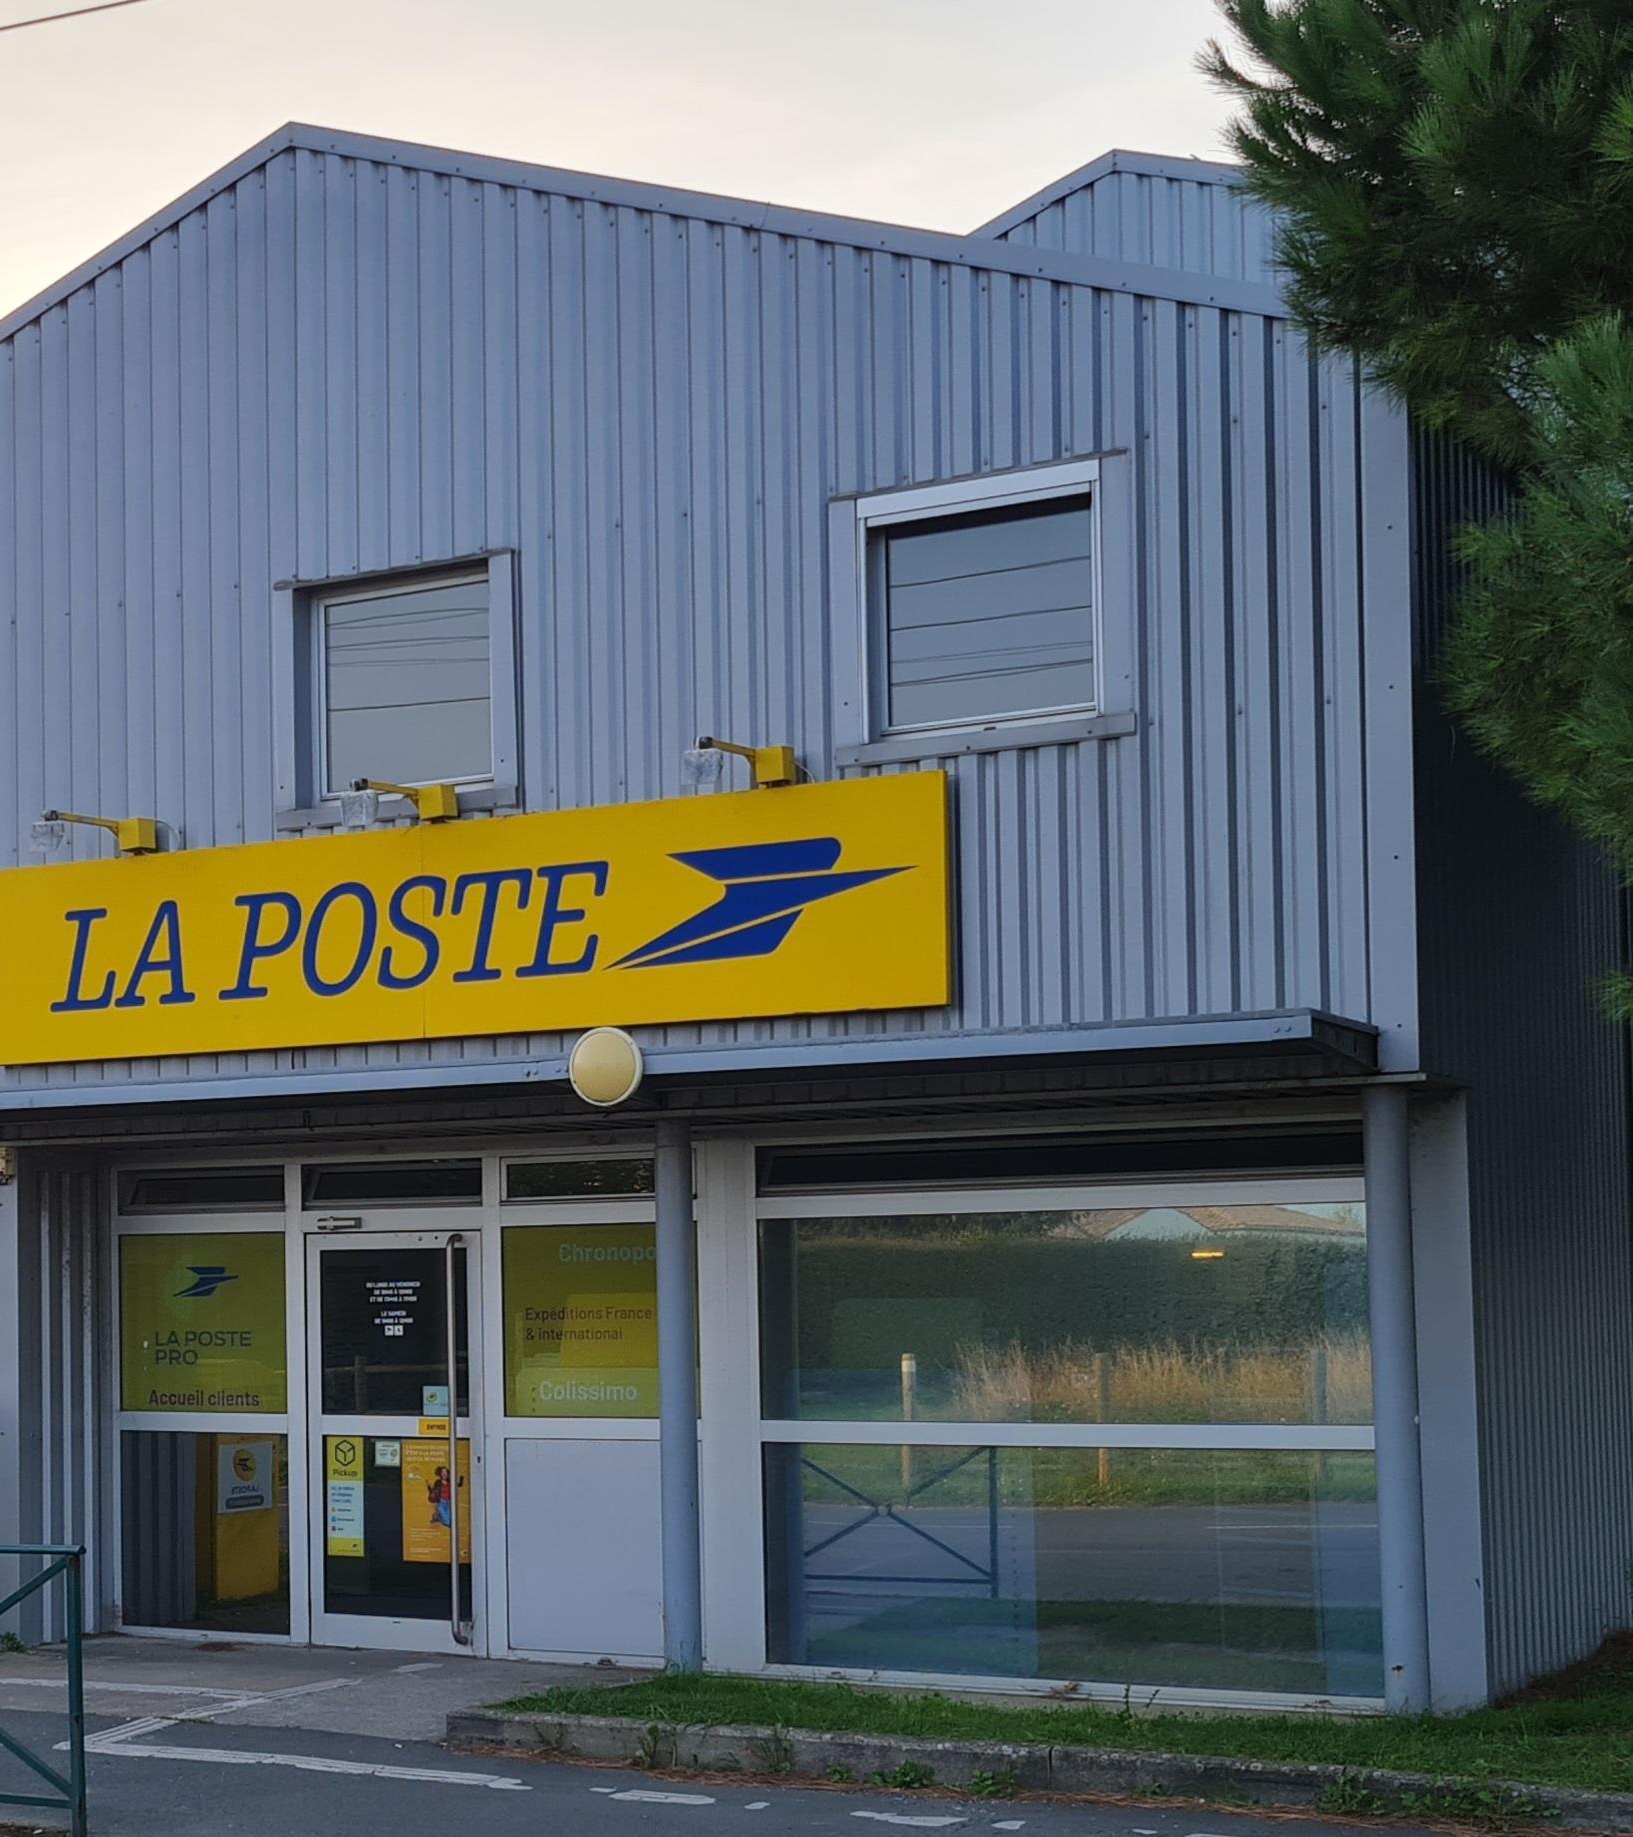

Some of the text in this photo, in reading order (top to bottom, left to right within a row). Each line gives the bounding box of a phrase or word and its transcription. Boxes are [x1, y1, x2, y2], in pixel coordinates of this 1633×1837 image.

[49, 860, 609, 1014] LA POSTE
[606, 1306, 653, 1320] France
[155, 1330, 252, 1347] LA POSTE
[525, 1327, 623, 1341] & international
[155, 1349, 199, 1365] PRO
[148, 1389, 260, 1406] Accueil clients
[539, 1380, 638, 1401] Colissimo
